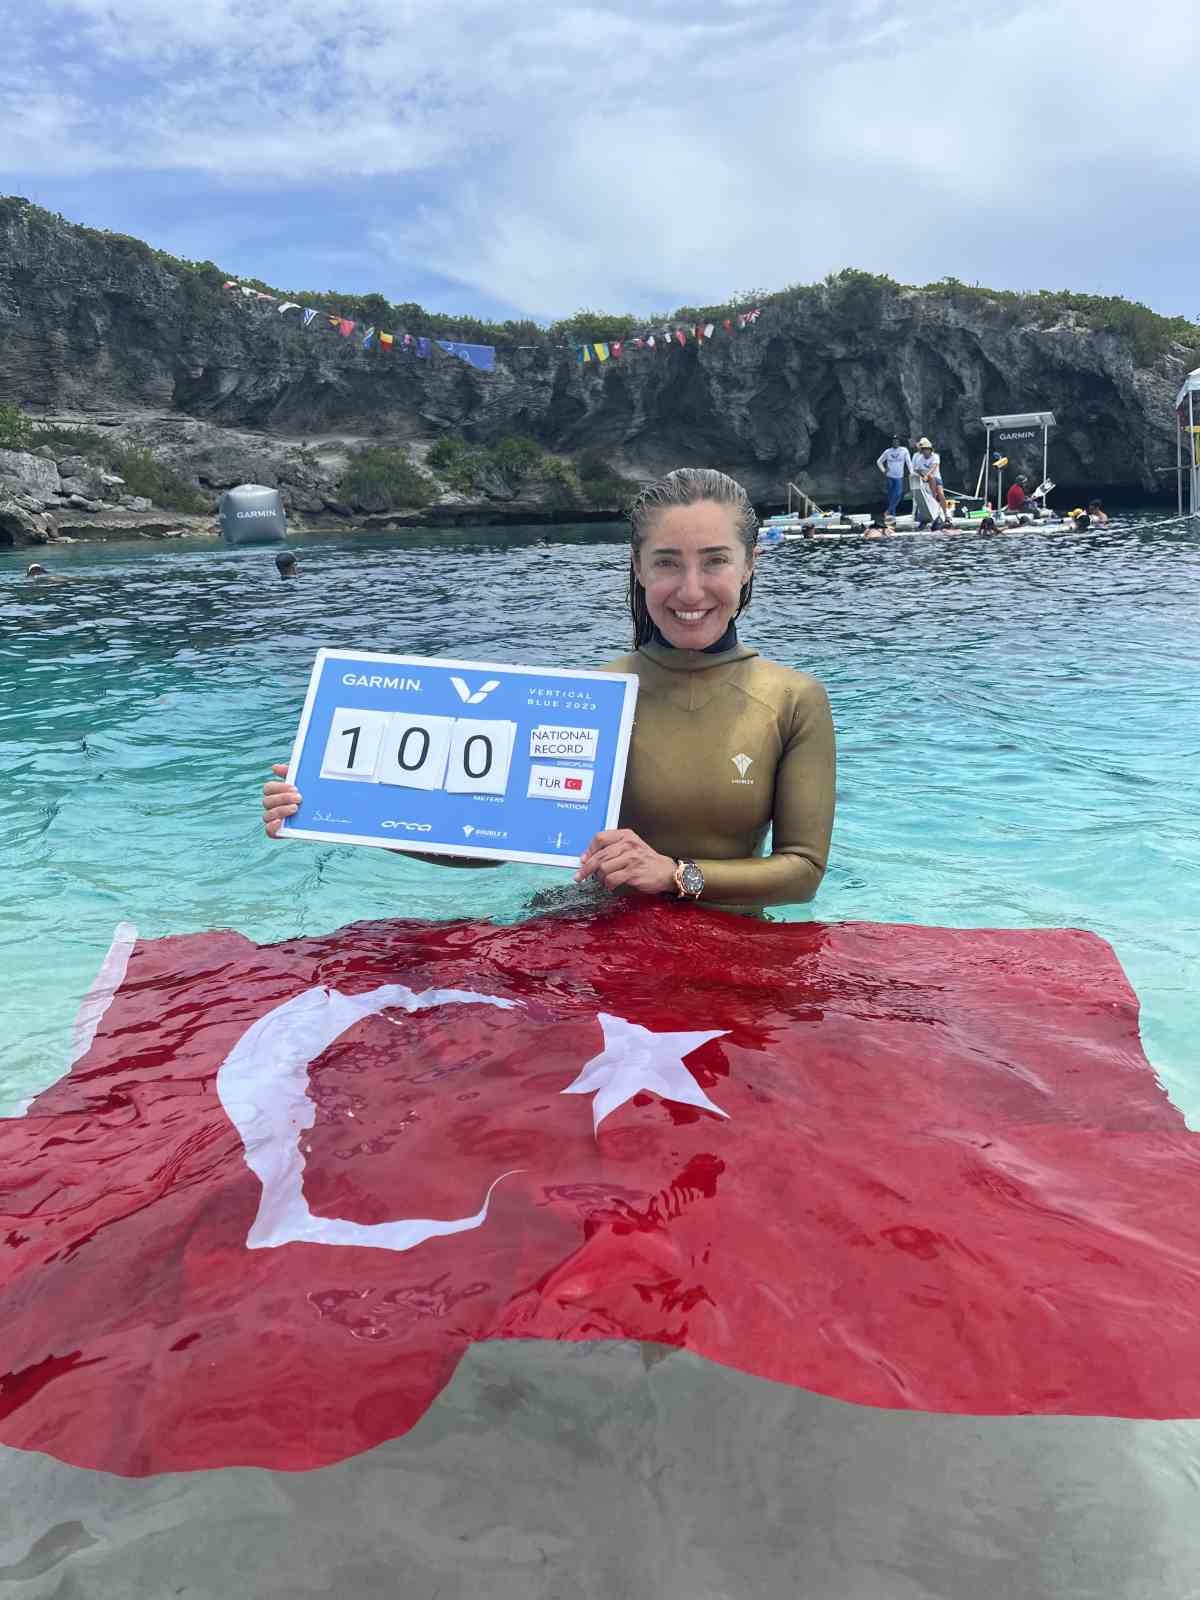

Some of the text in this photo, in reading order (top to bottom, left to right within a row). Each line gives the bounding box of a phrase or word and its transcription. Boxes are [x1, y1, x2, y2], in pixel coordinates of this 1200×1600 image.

[1000, 432, 1034, 440] GARMIN
[236, 510, 276, 519] GARMIN
[342, 673, 421, 692] GARMIN
[528, 687, 593, 700] VERTICAL
[527, 698, 598, 711] BLUE 2023
[532, 730, 593, 741] NATIONAL
[534, 744, 584, 754] RECORD
[538, 776, 561, 789] TUR
[556, 802, 589, 811] NATION
[380, 820, 433, 832] orca
